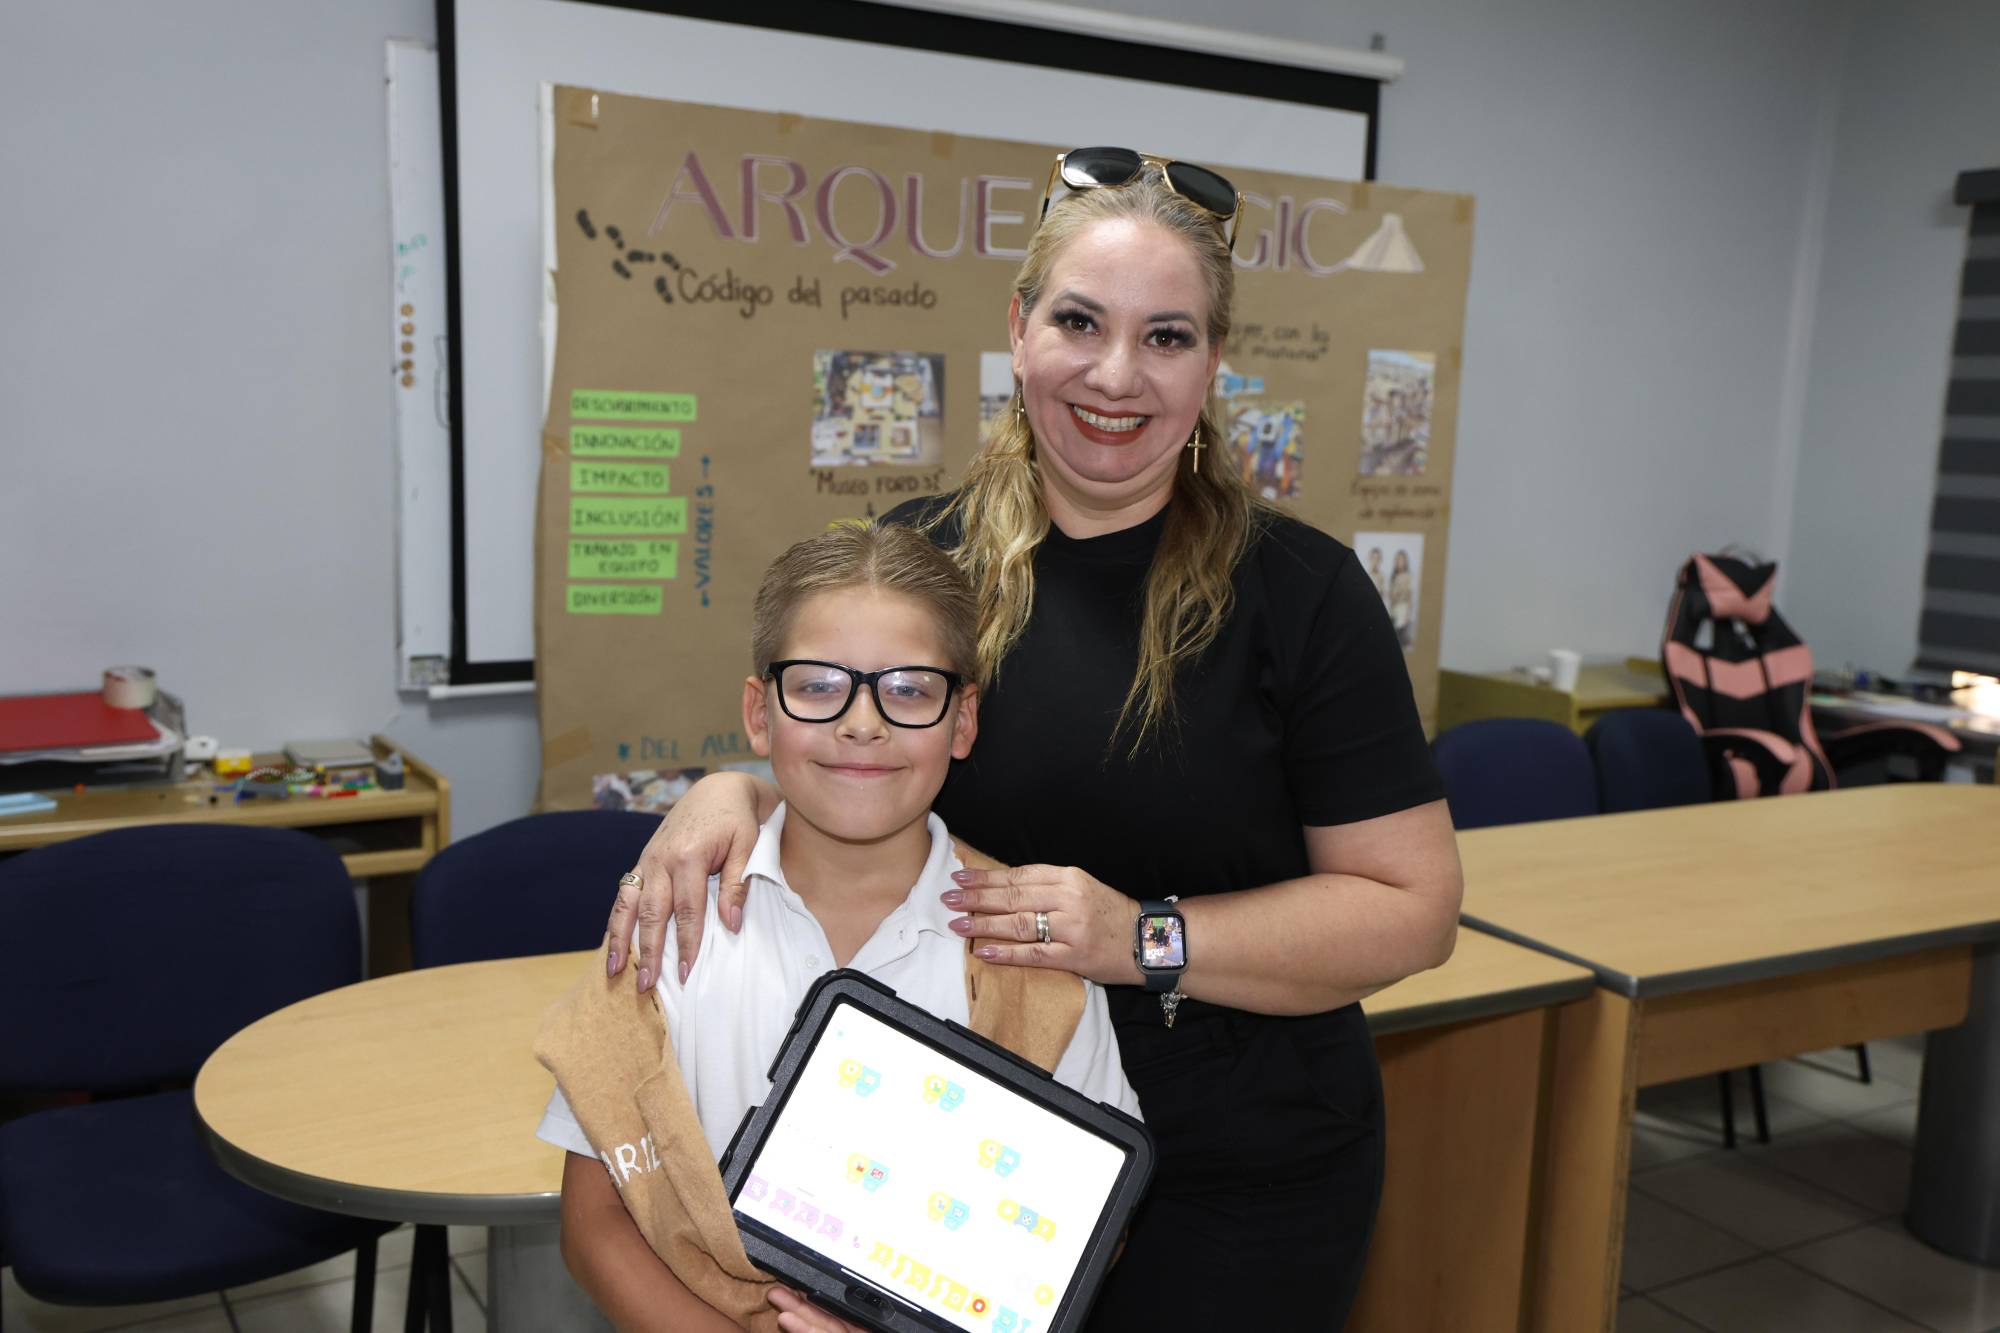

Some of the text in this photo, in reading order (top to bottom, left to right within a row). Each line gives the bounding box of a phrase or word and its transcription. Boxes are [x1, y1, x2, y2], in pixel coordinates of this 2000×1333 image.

[677, 266, 938, 320] Código del pasado
[579, 467, 666, 489] IMPACTO
[574, 505, 681, 529] INCLUSIÓN
[573, 543, 672, 559] TRABAJO EN
[598, 560, 660, 575] EQUIPO
[702, 730, 752, 758] AUL
